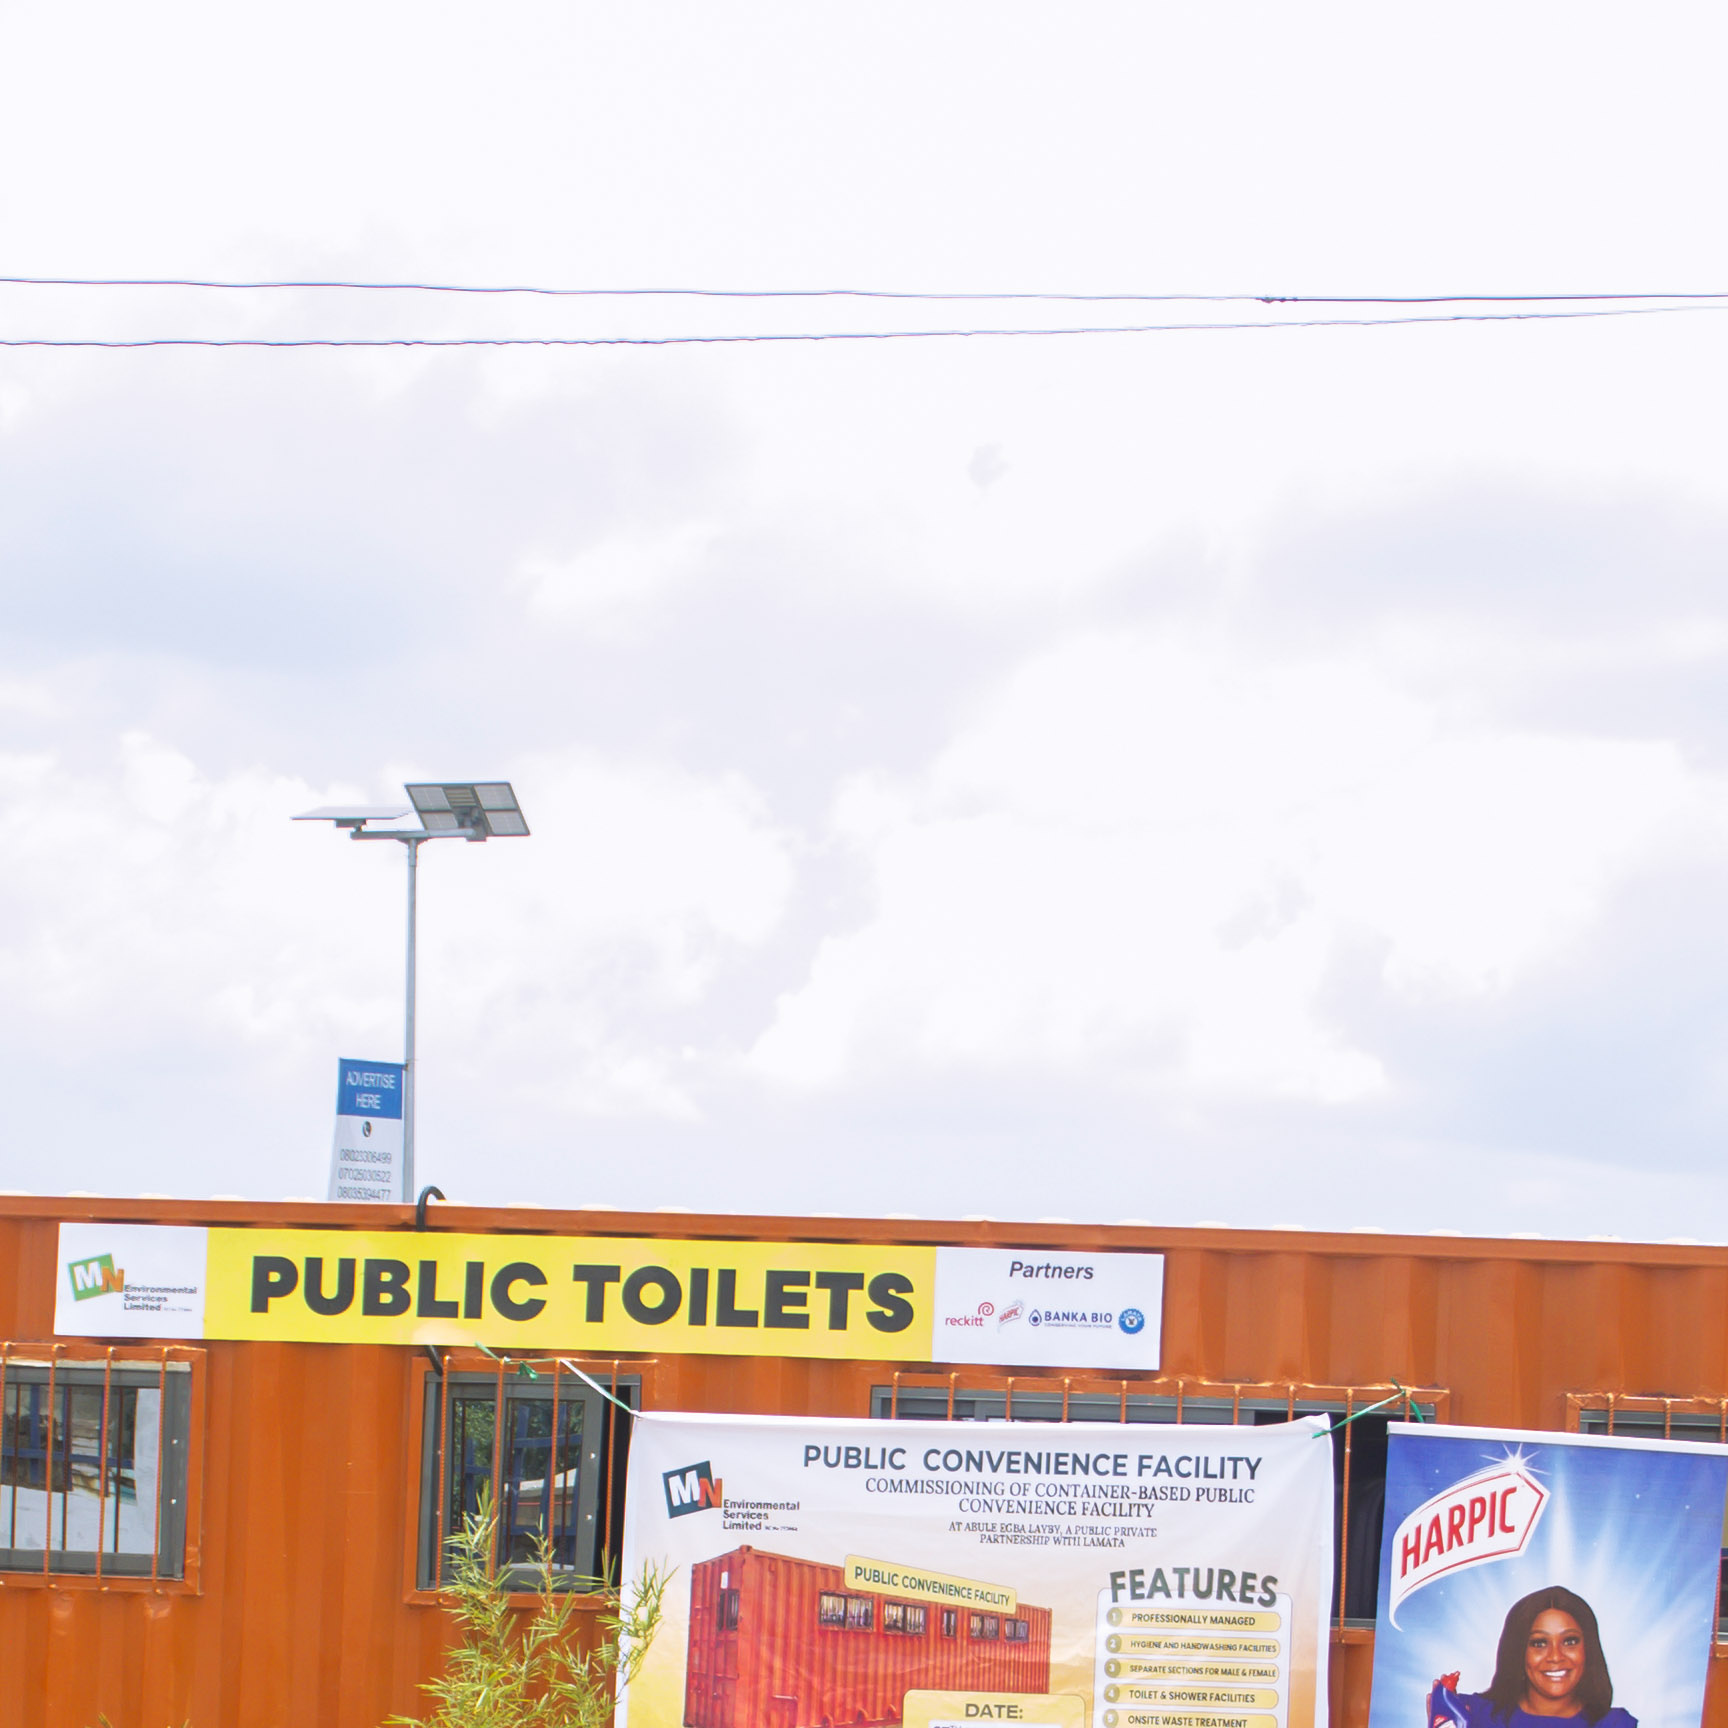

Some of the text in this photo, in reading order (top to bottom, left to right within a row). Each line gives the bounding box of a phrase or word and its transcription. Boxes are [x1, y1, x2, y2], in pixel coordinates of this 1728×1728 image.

[346, 1071, 396, 1089] ADVERTISE
[356, 1093, 382, 1109] HERE
[73, 1261, 124, 1292] MN
[1010, 1260, 1094, 1280] Partners
[124, 1285, 197, 1294] Environmental
[250, 1256, 914, 1333] PUBLIC TOILETS
[124, 1294, 168, 1302] Services
[124, 1302, 161, 1311] Limited
[945, 1315, 984, 1327] reckitt
[1044, 1311, 1112, 1324] BANKA BIO
[804, 1445, 1262, 1480] PUBLIC CONVENIENCE FACILITY
[668, 1470, 722, 1508] MN
[866, 1478, 1255, 1504] COMMISSIONING OF CONTAINER-BASED PUBLIC
[723, 1499, 800, 1510] Environmental
[959, 1498, 1154, 1518] CONVENIENCE FACILITY
[723, 1510, 769, 1520] Services
[722, 1521, 762, 1531] Limited
[949, 1521, 961, 1532] AT
[964, 1522, 997, 1532] ABULE
[1000, 1522, 1026, 1534] EGBA
[1066, 1526, 1072, 1535] A
[1074, 1526, 1111, 1536] PUBLIC
[1114, 1526, 1158, 1538] PRIVATE
[1400, 1486, 1517, 1580] HARPIC
[980, 1534, 1126, 1548] PARTNERSHIP WITH LAMATA
[854, 1566, 1010, 1606] PUBLIC CONVENIENCE FACILITY
[1110, 1568, 1278, 1608] FEATURES
[1132, 1613, 1207, 1624] PROFESSIONALLY
[1210, 1616, 1256, 1626] MANAGED
[1130, 1640, 1162, 1648] HYGIENE
[1180, 1642, 1238, 1652] HANDWASHING
[1238, 1644, 1277, 1652] FACILITIES
[1130, 1664, 1166, 1674] SEPARATE
[1167, 1666, 1204, 1675] SECTIONS
[1205, 1667, 1219, 1676] FOR
[1221, 1668, 1240, 1676] MALE
[1241, 1668, 1247, 1676] &
[1248, 1669, 1276, 1677] FEMALE
[1130, 1690, 1158, 1700] TOILET
[1160, 1691, 1166, 1700] &
[1169, 1692, 1208, 1702] SHOWER
[1210, 1693, 1256, 1703] FACILITIES
[965, 1704, 1023, 1719] DATE:
[1128, 1715, 1160, 1726] ONSITE
[1162, 1716, 1193, 1726] WASTE
[1195, 1718, 1248, 1728] TREATMENT
